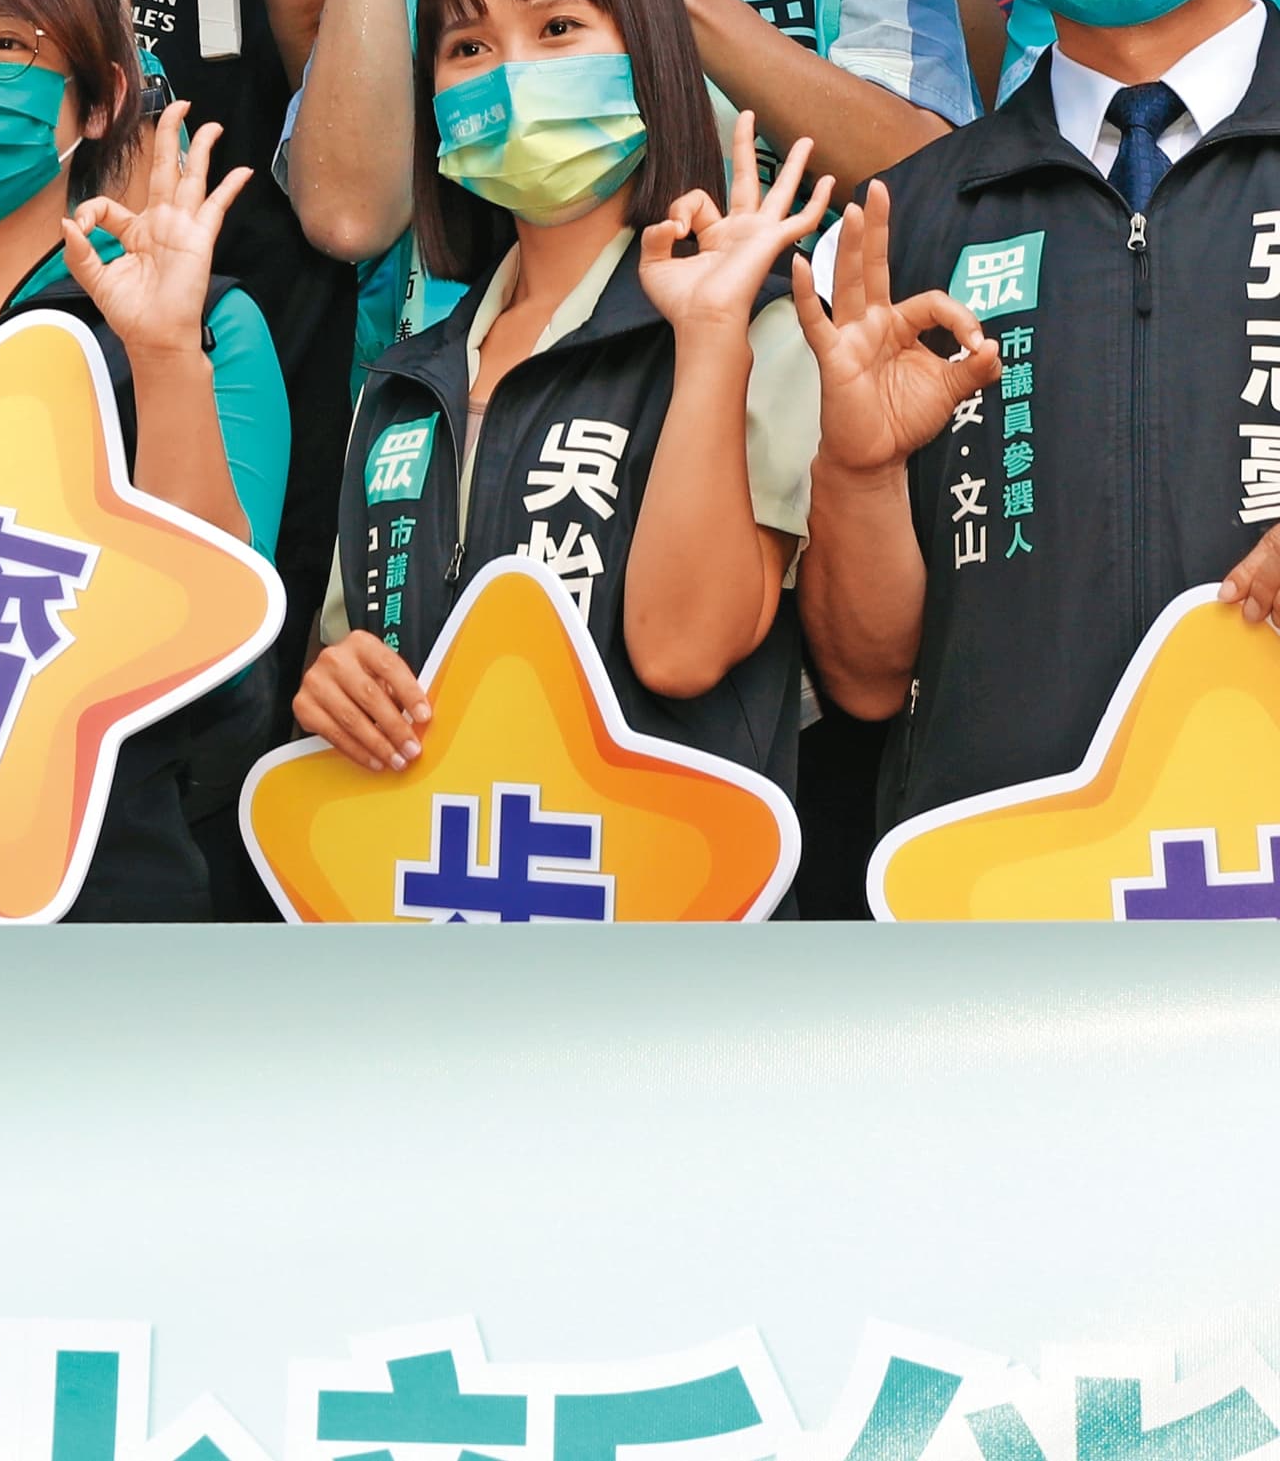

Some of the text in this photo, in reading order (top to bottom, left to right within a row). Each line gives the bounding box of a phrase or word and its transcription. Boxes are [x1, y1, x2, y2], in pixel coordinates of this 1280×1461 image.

[1000, 325, 1035, 560] 市議員參選人
